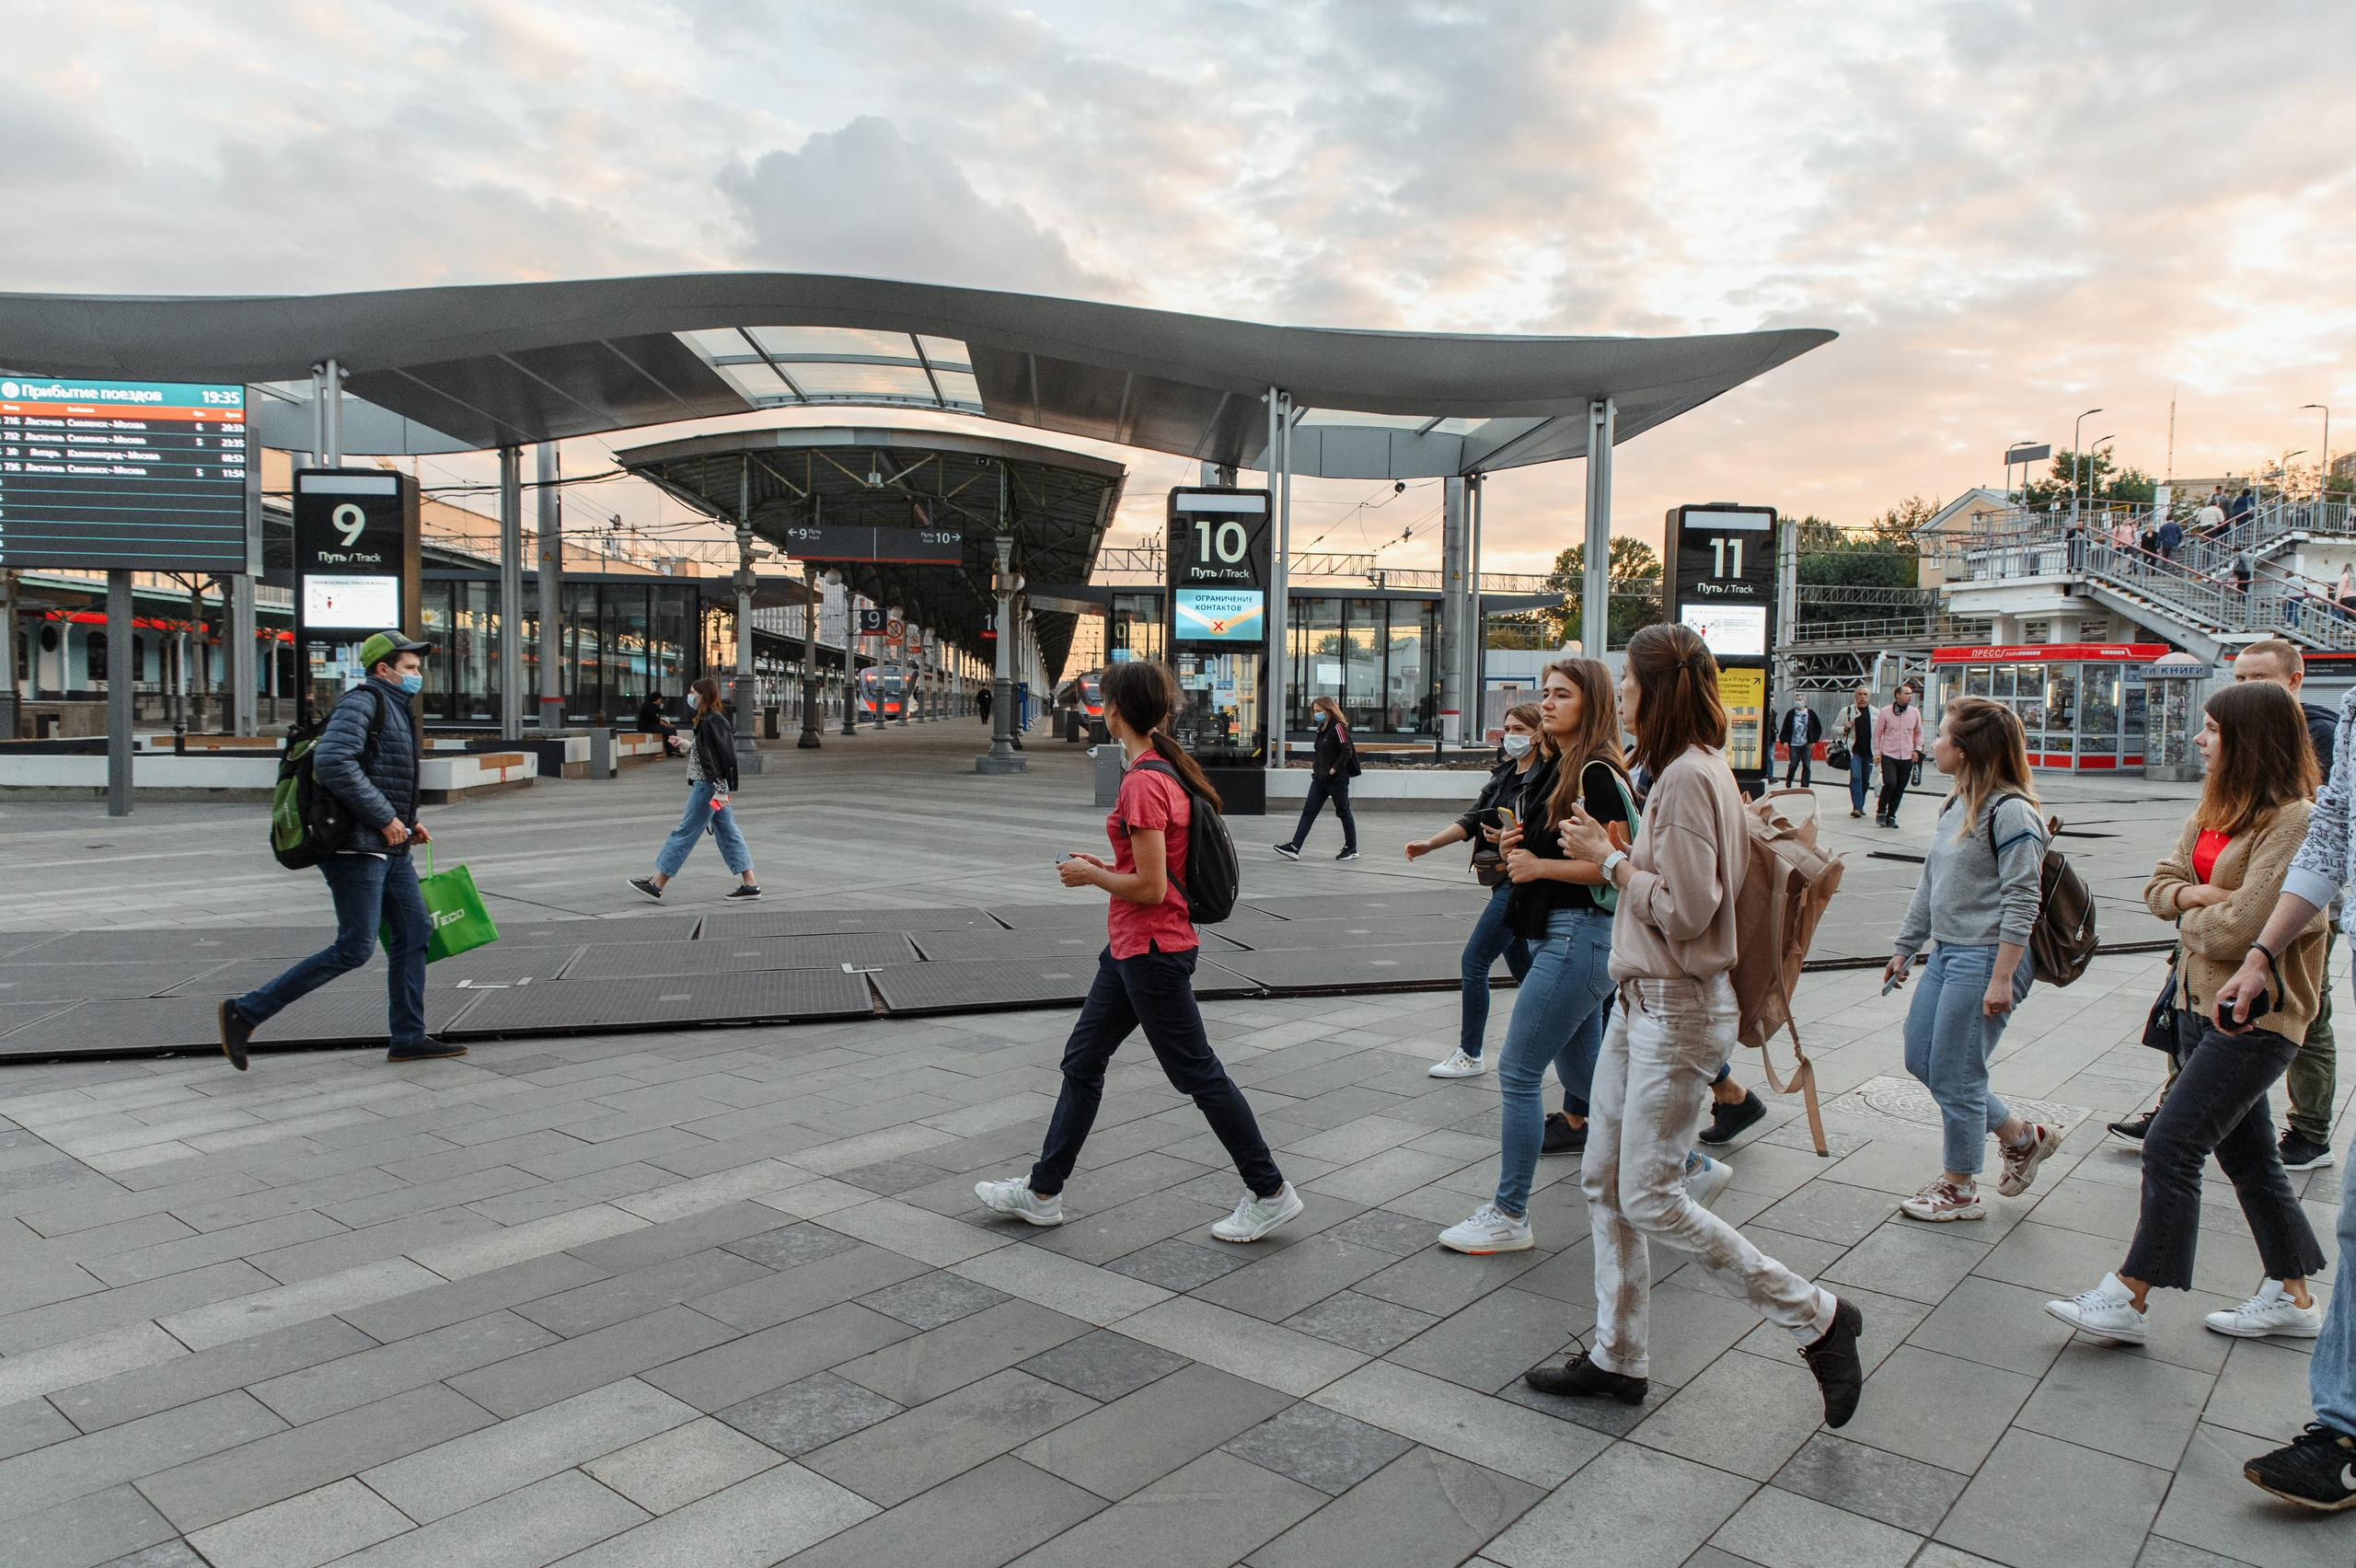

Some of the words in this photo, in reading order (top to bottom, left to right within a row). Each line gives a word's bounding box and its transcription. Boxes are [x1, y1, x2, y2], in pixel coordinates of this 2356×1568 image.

[21, 384, 98, 399] Прибытие
[100, 388, 163, 402] поездов
[202, 390, 241, 404] 19:35
[332, 503, 365, 547] 9
[799, 528, 807, 540] 9
[935, 532, 951, 544] 10
[1195, 521, 1247, 563] 10
[318, 551, 348, 563] Путь
[355, 553, 382, 562] Track
[1709, 537, 1743, 579] 11
[1191, 567, 1218, 579] Путь
[1225, 569, 1250, 579] Track
[1697, 582, 1723, 594] Путь
[1730, 584, 1754, 594] Track
[1195, 594, 1253, 603] ОГРАНИЧЕНИЕ
[868, 611, 881, 629] 9
[1971, 649, 2002, 657] ПРЕСС
[2161, 666, 2203, 674] КНИГИ
